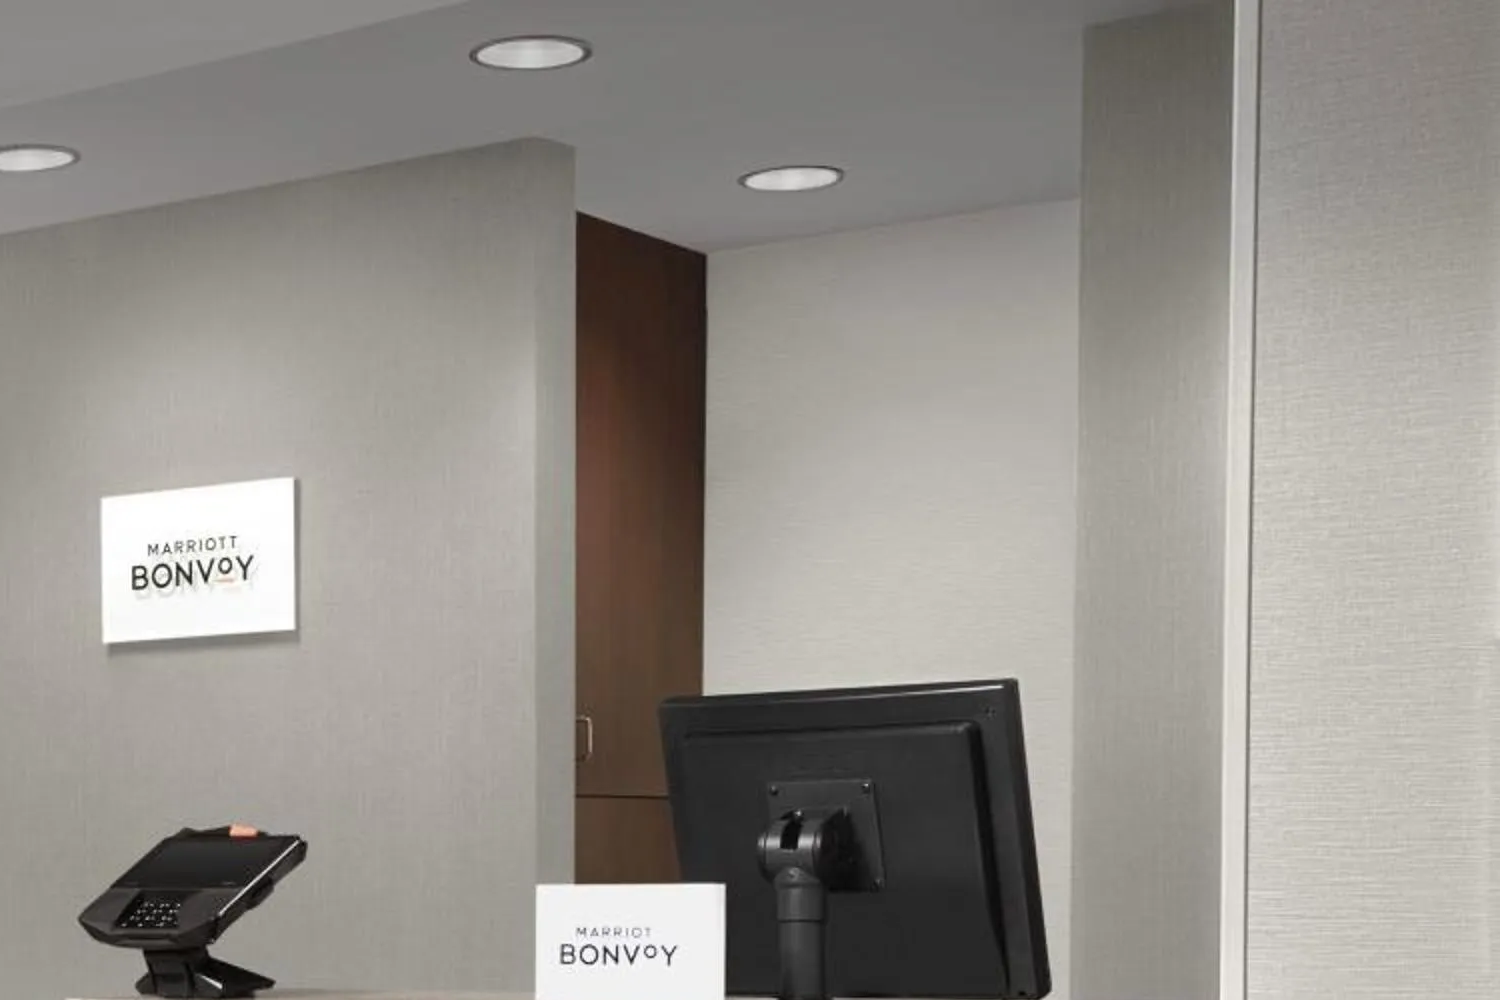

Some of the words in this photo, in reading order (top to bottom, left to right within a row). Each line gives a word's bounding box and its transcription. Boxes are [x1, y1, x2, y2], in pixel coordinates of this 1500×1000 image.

[147, 535, 237, 556] MARRIOTT
[131, 555, 254, 590] BONVOY
[560, 943, 677, 966] BONVOY
